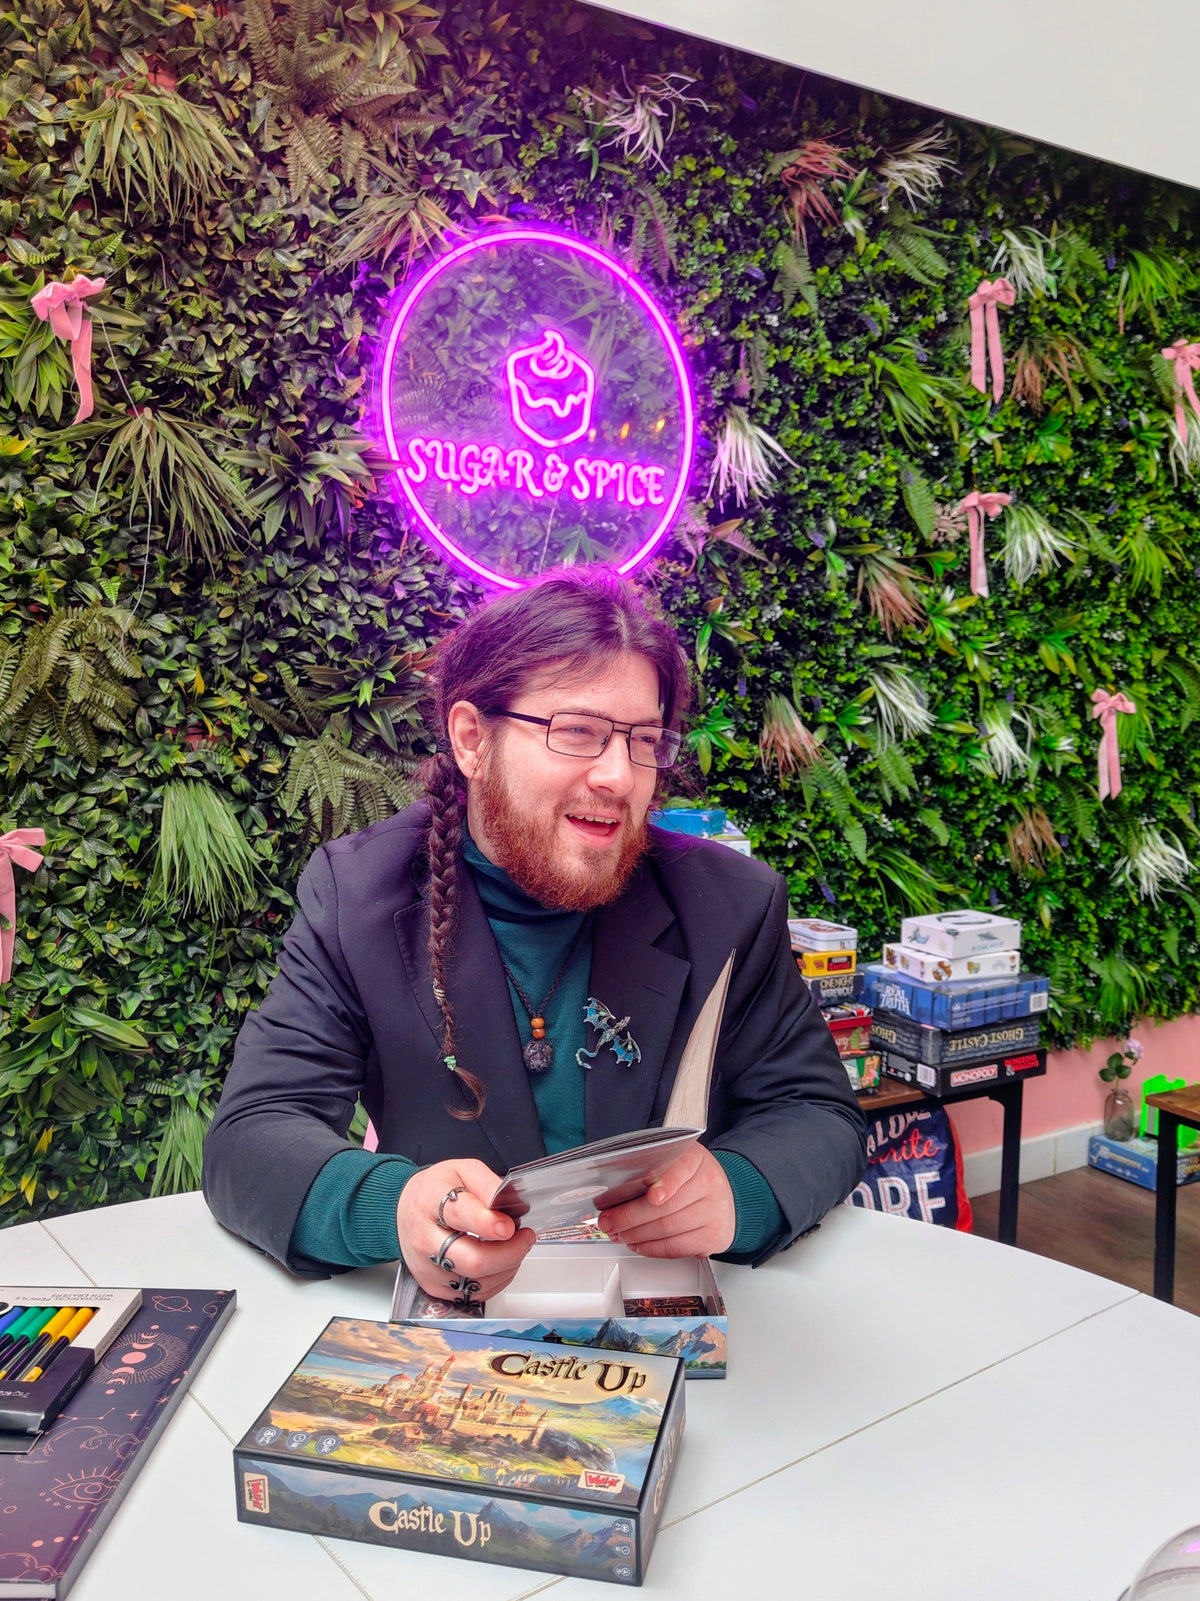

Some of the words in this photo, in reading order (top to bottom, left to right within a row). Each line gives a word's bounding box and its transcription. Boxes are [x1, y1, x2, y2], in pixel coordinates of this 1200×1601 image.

[405, 437, 544, 497] SUGAR
[543, 453, 570, 493] &
[570, 457, 666, 507] SPICE
[879, 993, 911, 1016] TRUTH
[949, 1033, 989, 1052] CASTLE
[990, 1027, 1024, 1044] GHOST
[952, 1066, 997, 1084] MONOPOLY
[490, 1352, 589, 1380] Castle
[595, 1360, 648, 1394] Up
[368, 1500, 448, 1535] Castle
[448, 1509, 492, 1548] Up
